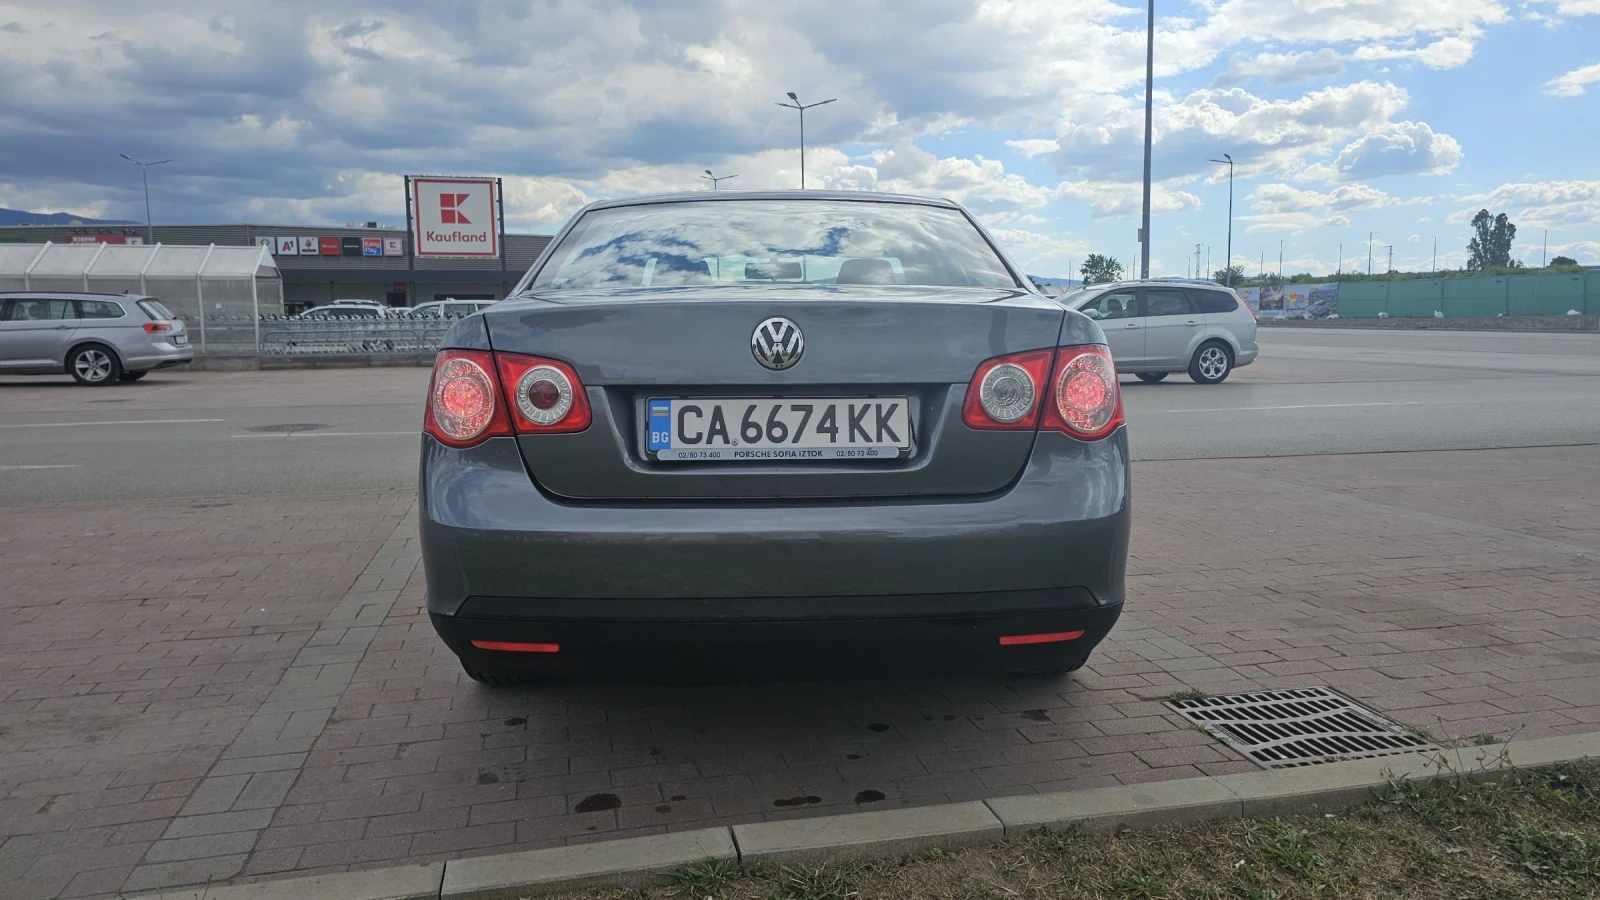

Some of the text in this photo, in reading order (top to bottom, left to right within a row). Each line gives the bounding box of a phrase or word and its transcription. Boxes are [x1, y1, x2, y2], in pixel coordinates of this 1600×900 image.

[440, 193, 472, 224] K
[426, 231, 487, 243] Kaufland
[281, 240, 294, 252] A1
[677, 403, 901, 445] CA 6674 KK
[651, 431, 669, 444] BG
[678, 451, 698, 459] 02/80
[699, 451, 707, 459] 73
[708, 451, 721, 459] 400
[773, 450, 797, 458] SOFIA
[836, 449, 856, 458] 02/80
[856, 449, 865, 457] 73
[866, 449, 879, 457] 400
